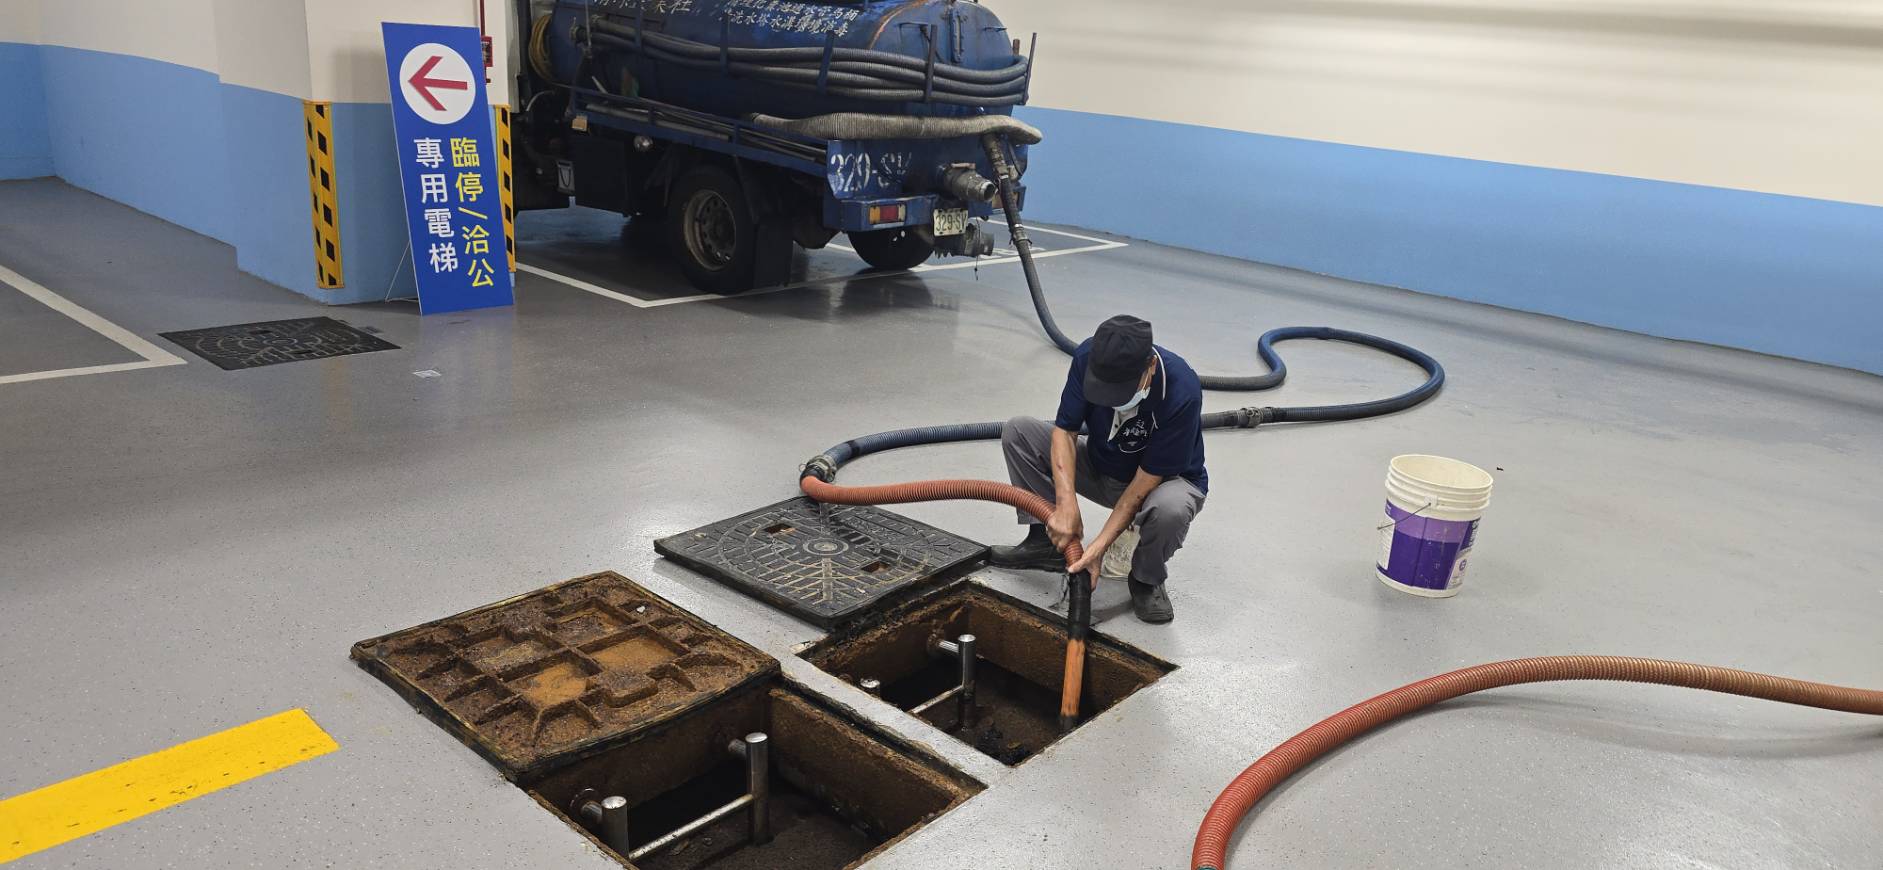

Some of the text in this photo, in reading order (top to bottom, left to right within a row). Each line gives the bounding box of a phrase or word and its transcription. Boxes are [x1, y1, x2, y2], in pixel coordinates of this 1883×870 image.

[413, 136, 459, 274] 專用電梯
[449, 136, 496, 288] 臨停/洽公
